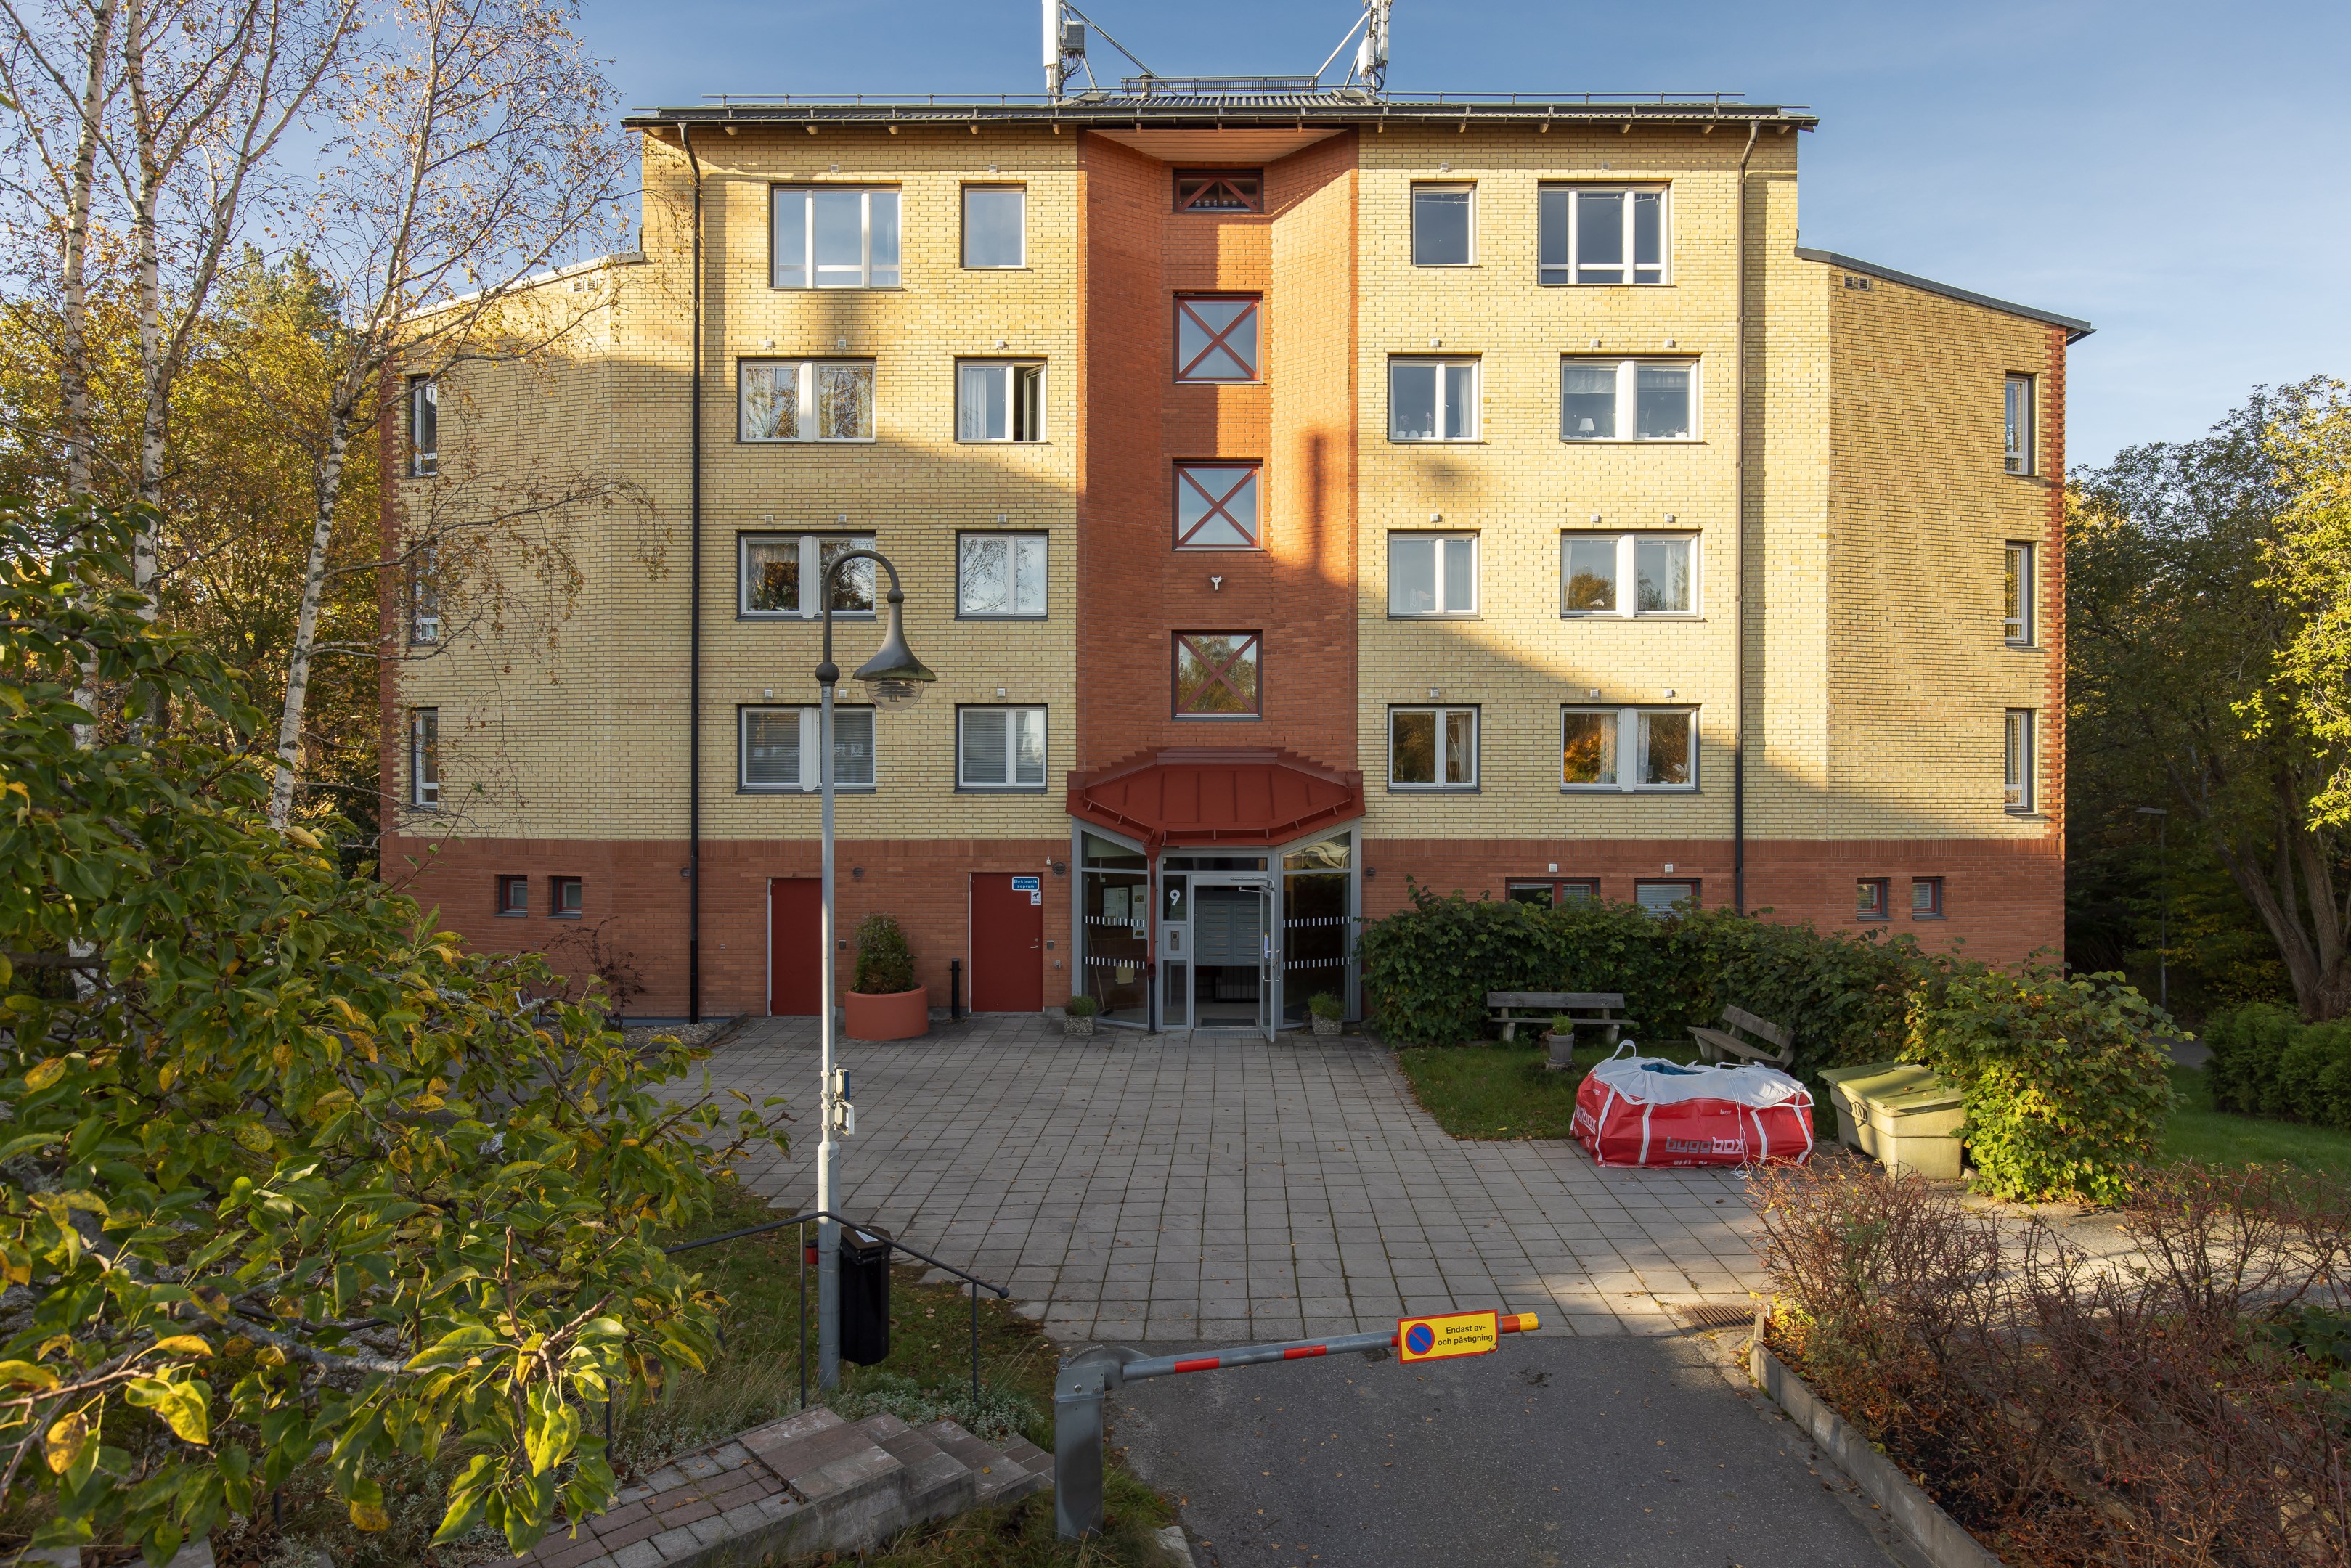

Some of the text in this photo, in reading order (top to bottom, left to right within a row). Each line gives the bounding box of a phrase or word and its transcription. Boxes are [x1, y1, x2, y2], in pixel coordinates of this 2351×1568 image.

[1170, 889, 1181, 906] 9
[1665, 1136, 1744, 1154] byggbox
[1446, 1324, 1472, 1334] Endast
[1454, 1334, 1493, 1346] påstigning
